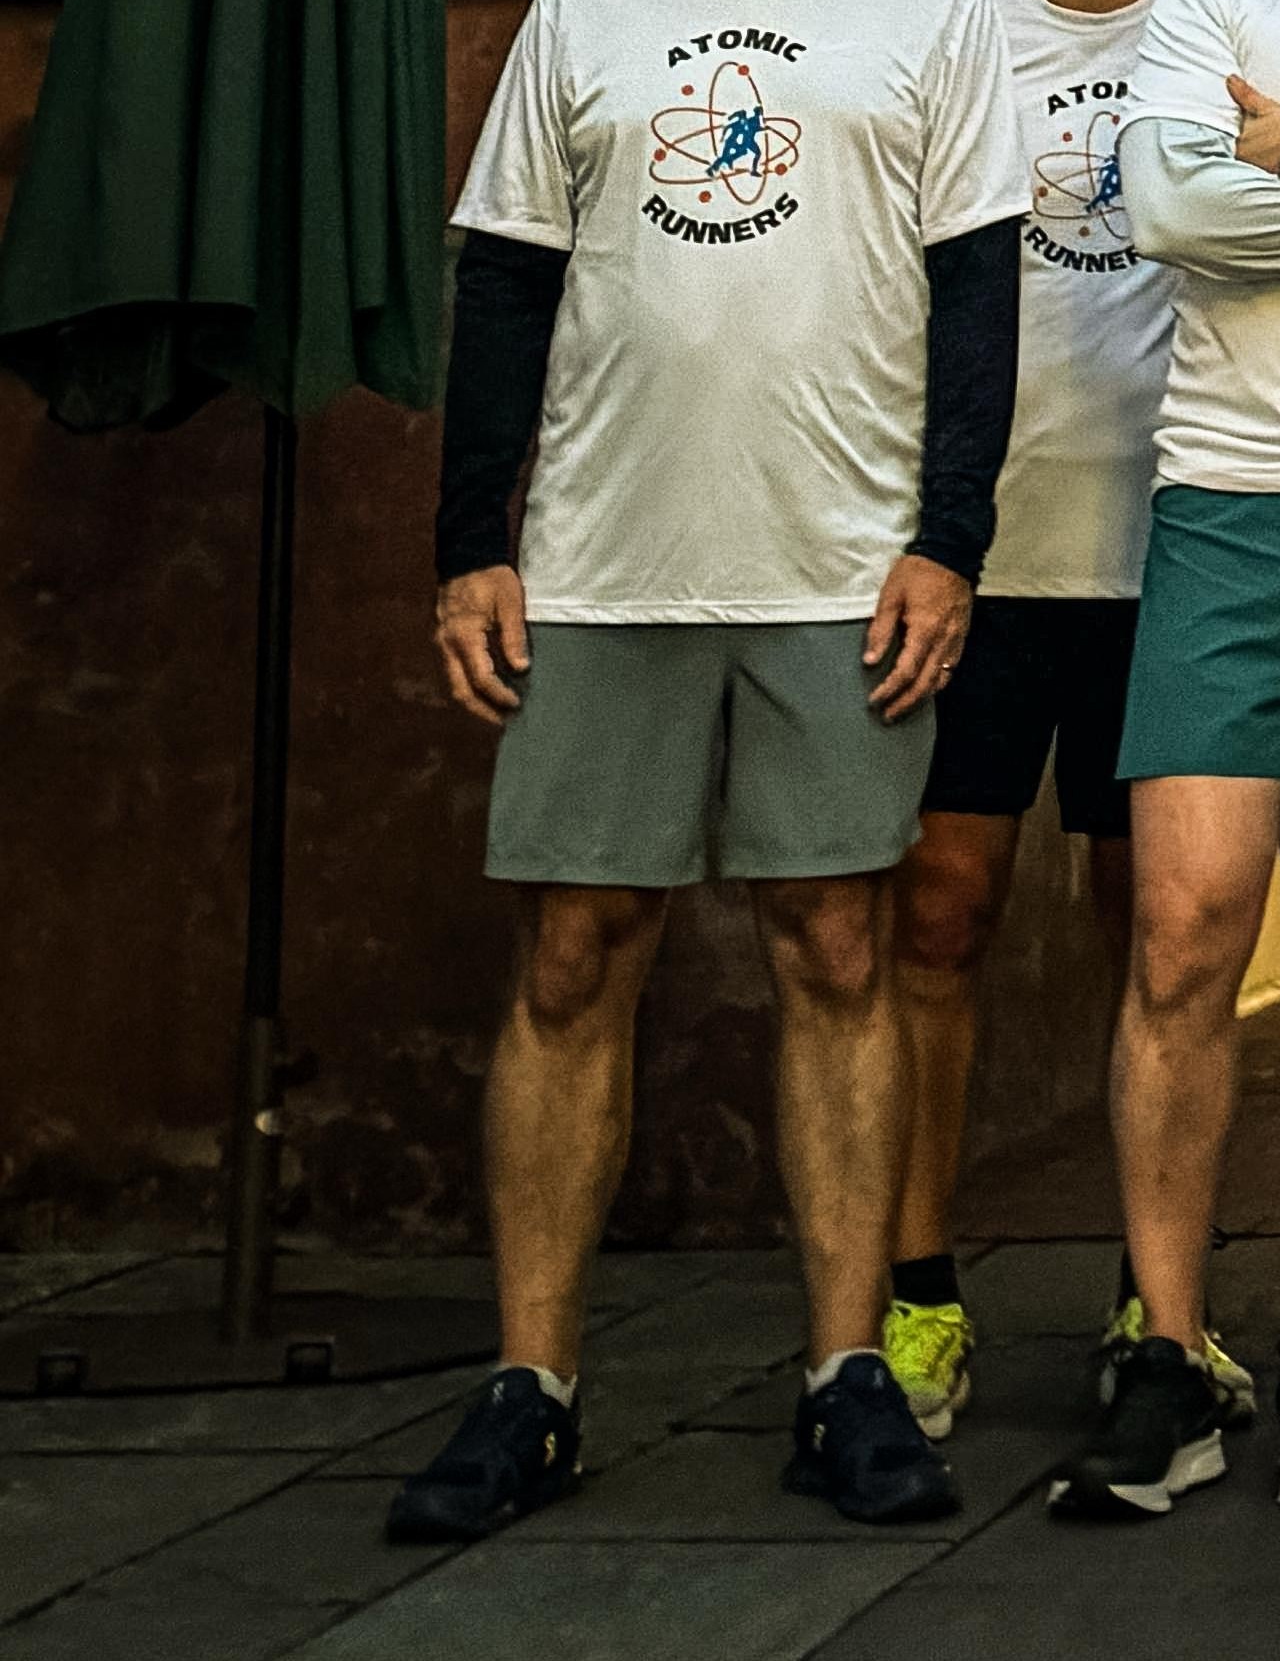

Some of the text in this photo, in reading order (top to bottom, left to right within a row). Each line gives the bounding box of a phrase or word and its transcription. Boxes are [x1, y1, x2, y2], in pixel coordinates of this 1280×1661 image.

[667, 28, 806, 68] ATOMIC
[1047, 81, 1128, 116] ATO
[642, 192, 799, 244] RUNNERS
[1024, 226, 1136, 273] RUNNE
